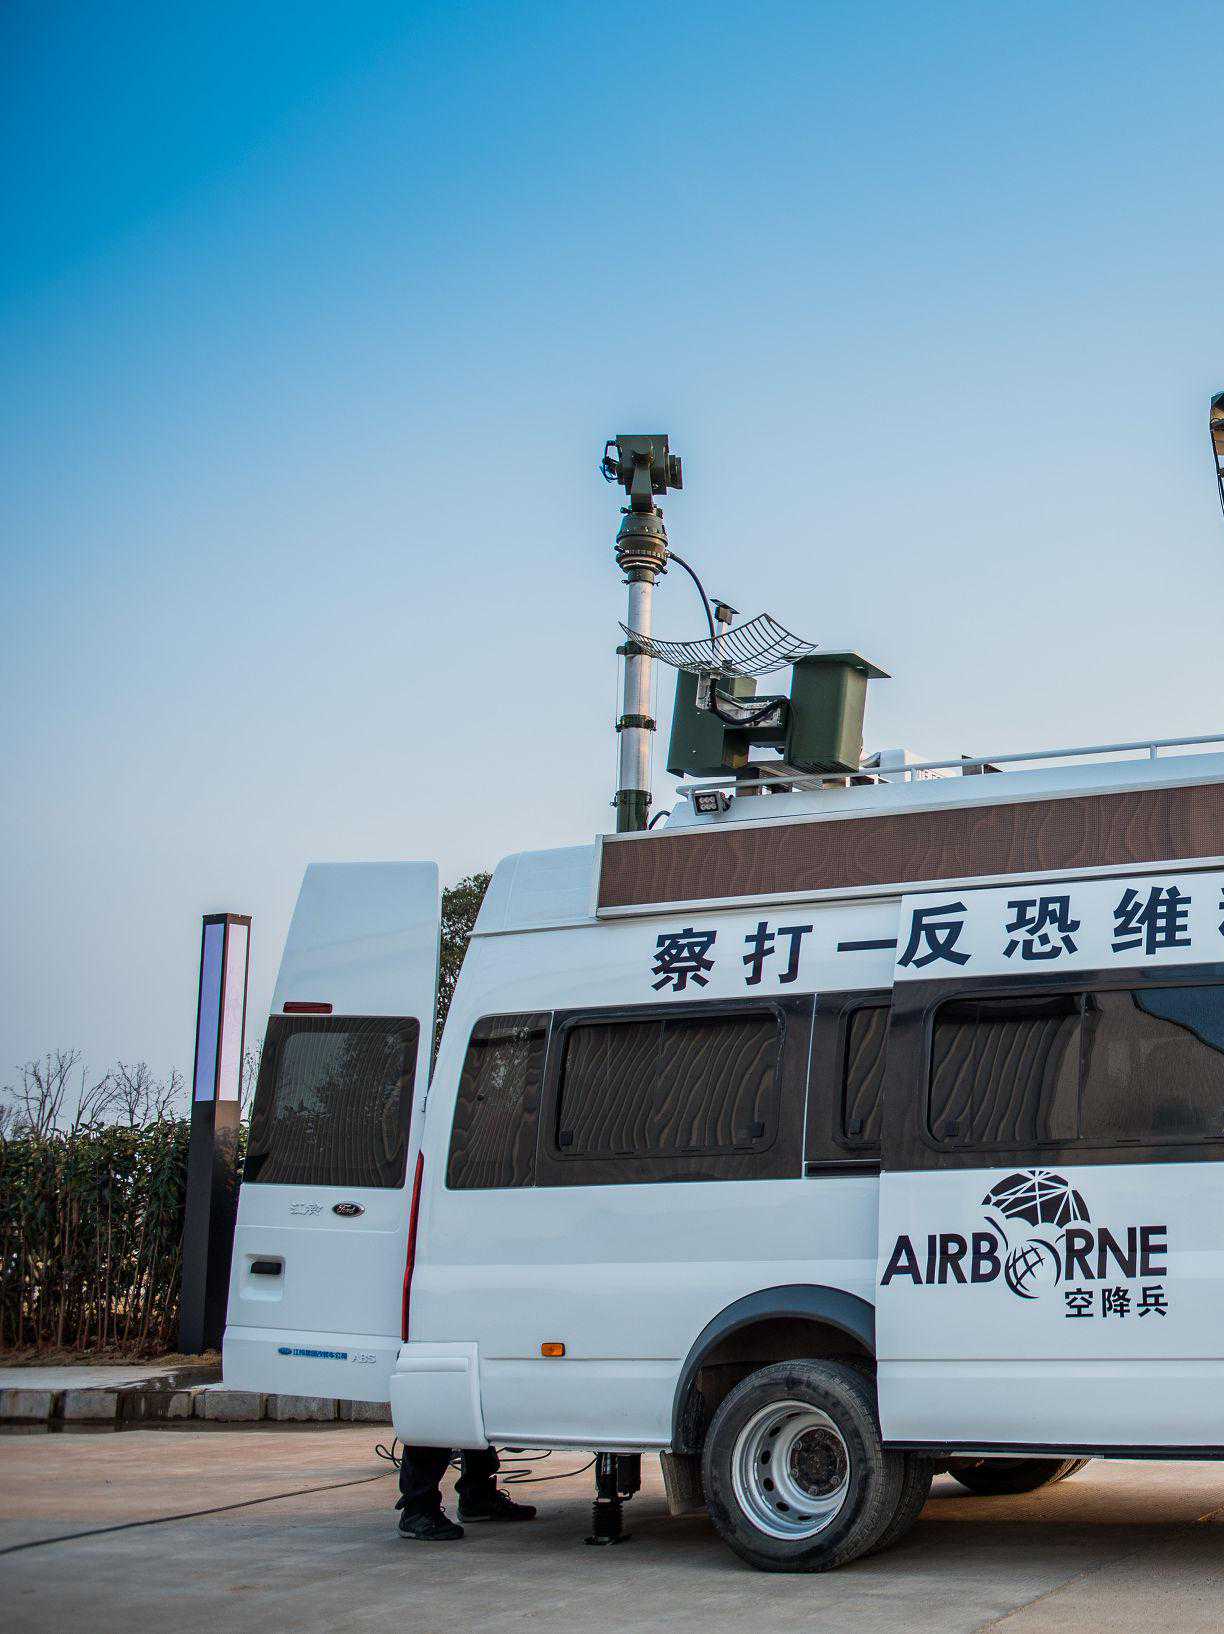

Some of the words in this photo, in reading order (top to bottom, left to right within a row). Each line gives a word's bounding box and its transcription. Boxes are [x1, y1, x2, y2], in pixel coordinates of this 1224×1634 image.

[1064, 1284, 1169, 1319] 空降兵
[352, 1352, 377, 1364] ABS
